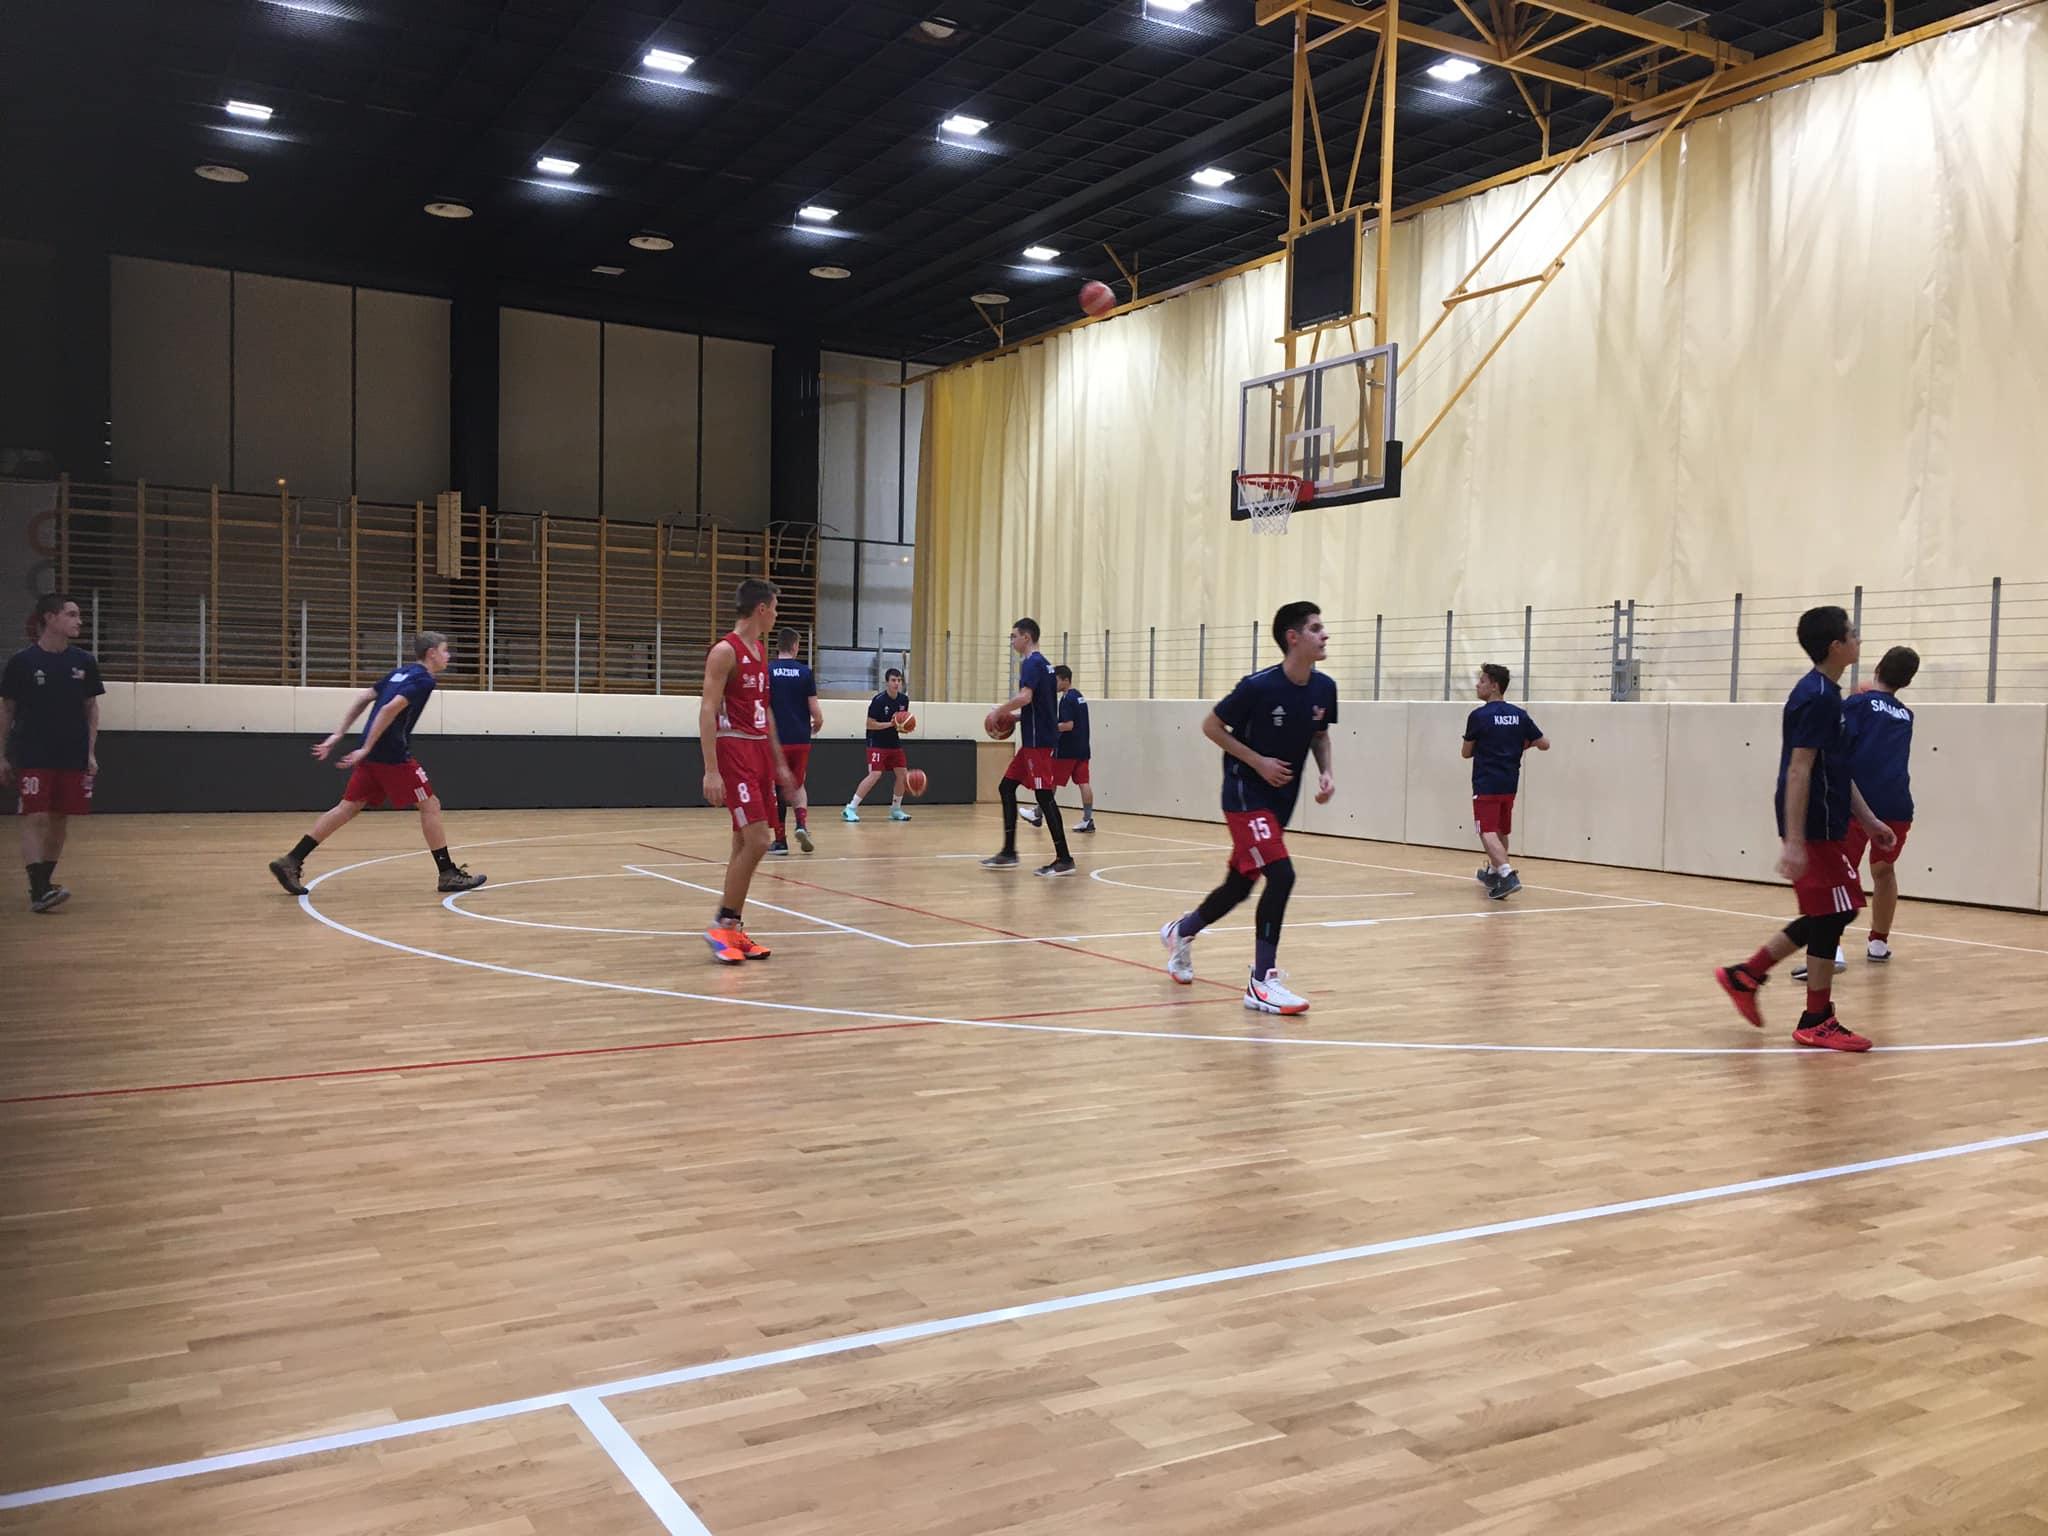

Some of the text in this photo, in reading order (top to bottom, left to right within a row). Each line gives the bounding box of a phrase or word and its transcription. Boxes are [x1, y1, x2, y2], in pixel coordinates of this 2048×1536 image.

[1494, 714, 1519, 726] KASZAI
[871, 751, 881, 762] 21
[22, 776, 39, 795] 30
[737, 782, 751, 803] 8
[1248, 816, 1272, 842] 15
